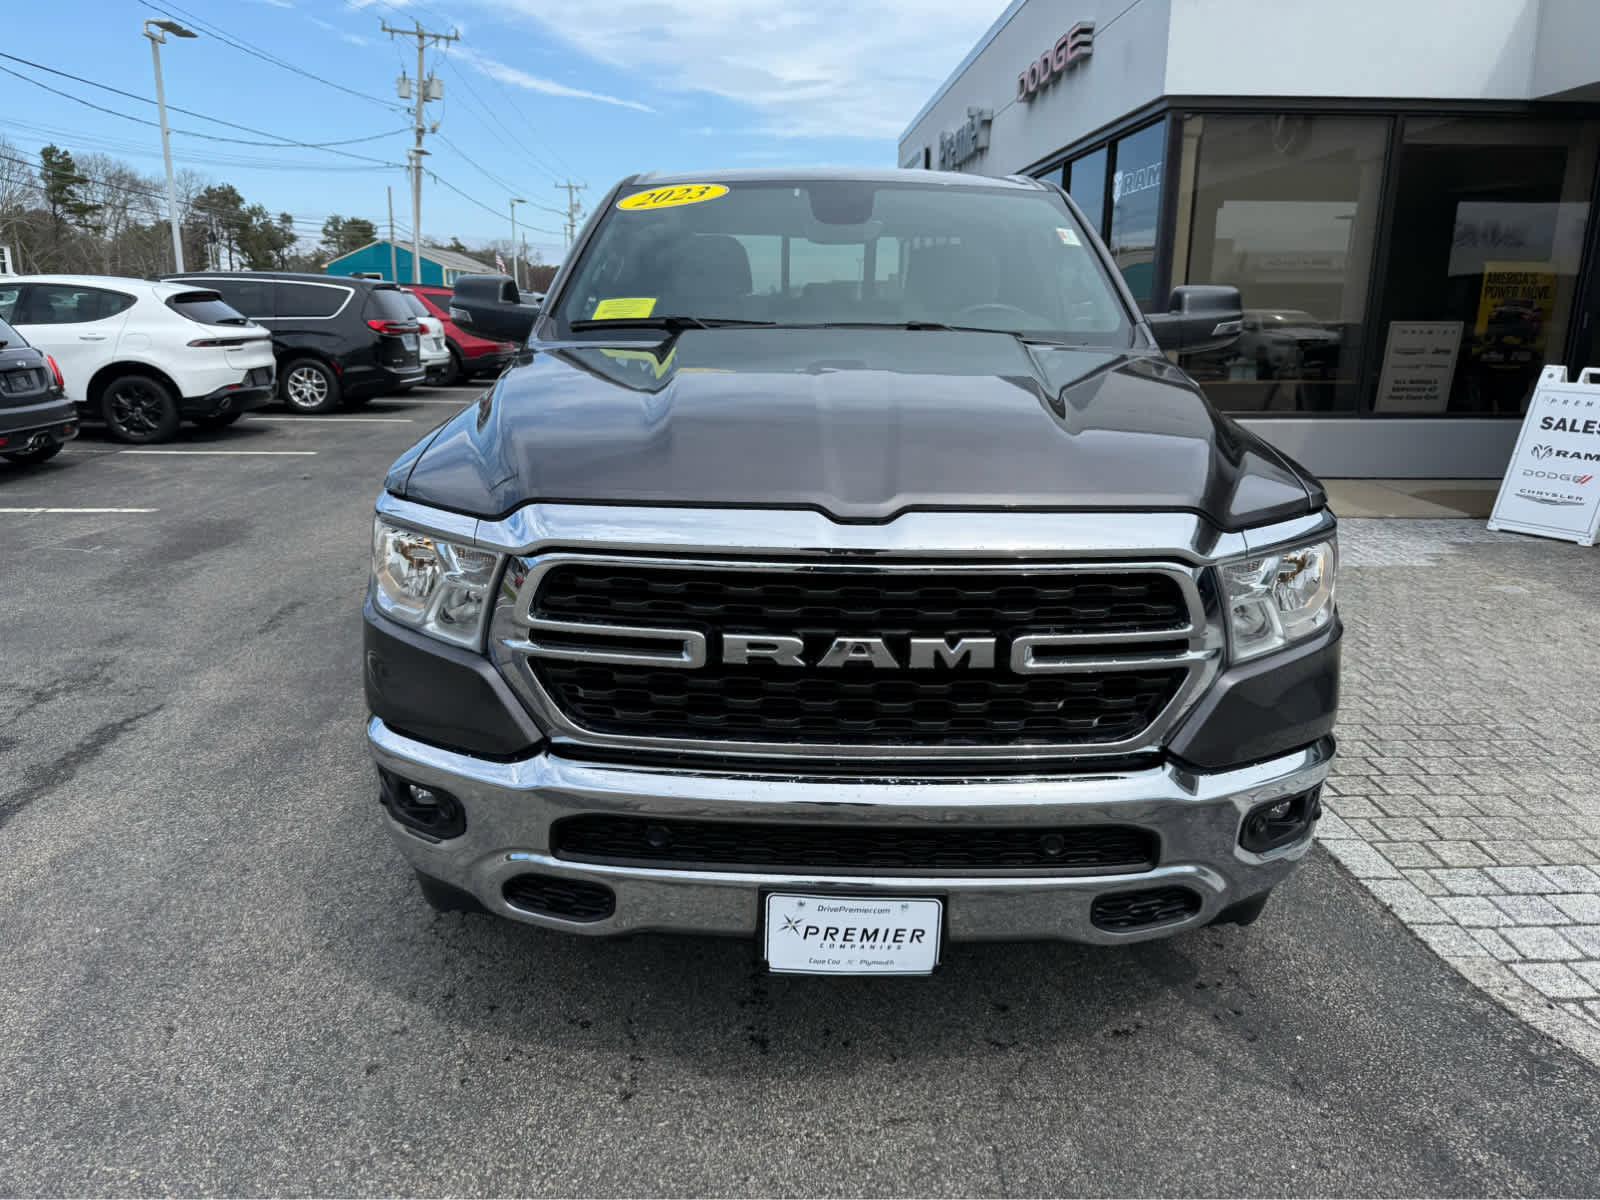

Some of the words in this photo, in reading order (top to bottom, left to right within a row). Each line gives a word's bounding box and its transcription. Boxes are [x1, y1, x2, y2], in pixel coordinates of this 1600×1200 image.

[1017, 21, 1095, 103] DODGE
[1121, 161, 1162, 196] RAM
[633, 185, 711, 207] 2023
[1550, 398, 1600, 408] PREM
[1555, 450, 1600, 462] RAM
[1522, 469, 1583, 484] DODGE
[1519, 488, 1584, 501] CHRYSLER
[722, 634, 996, 669] RAM
[817, 904, 891, 914] DrivePremier.com
[803, 925, 925, 943] PREMIER
[820, 943, 902, 951] COMPANIES
[859, 958, 894, 967] Plymouth
